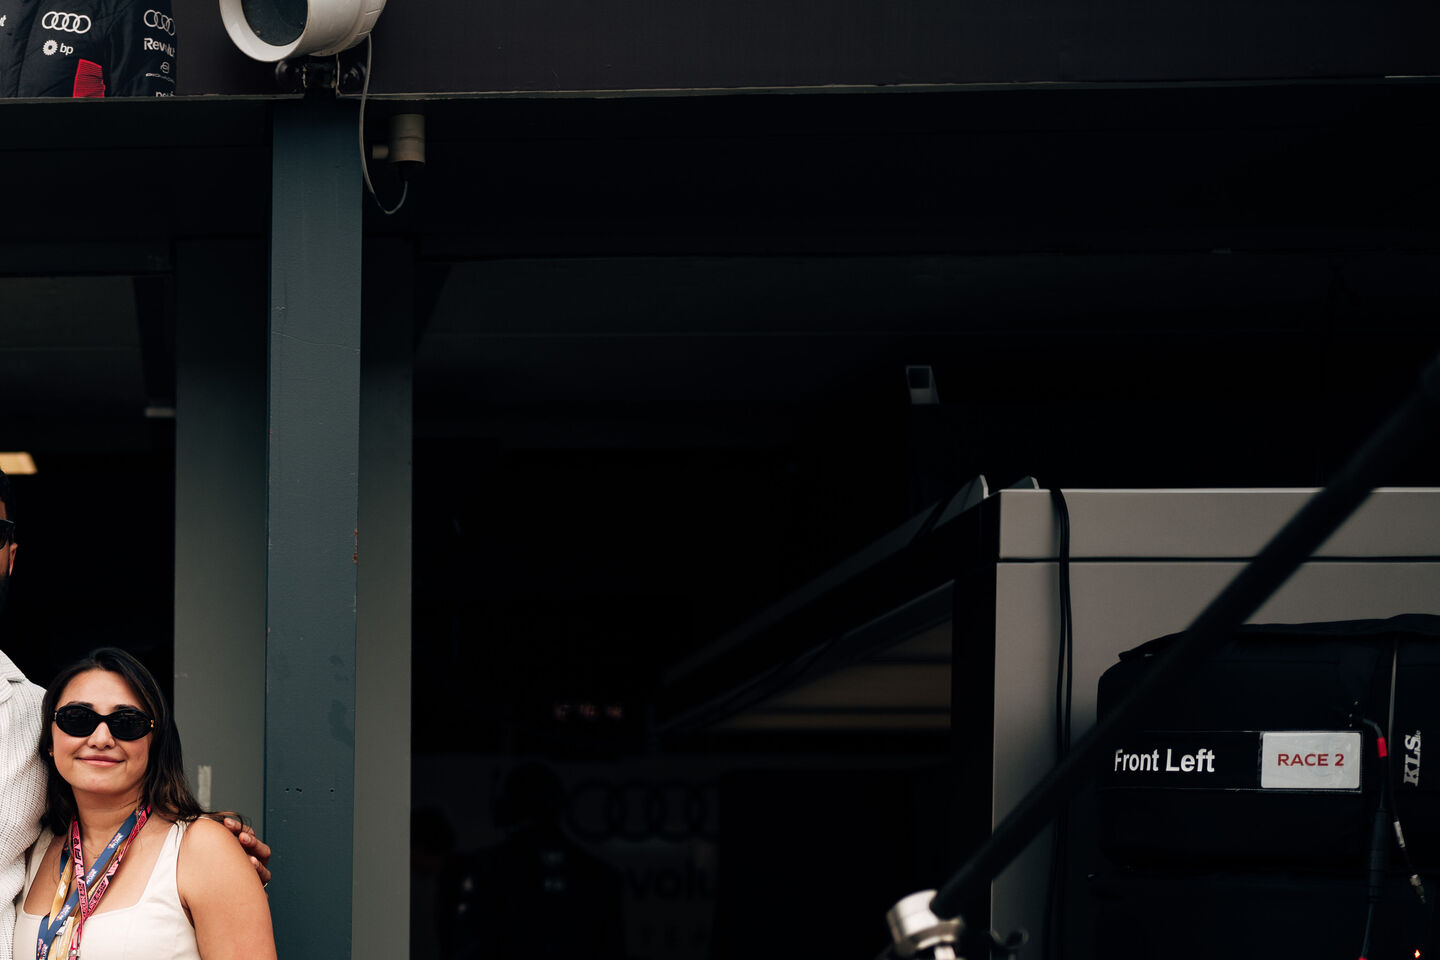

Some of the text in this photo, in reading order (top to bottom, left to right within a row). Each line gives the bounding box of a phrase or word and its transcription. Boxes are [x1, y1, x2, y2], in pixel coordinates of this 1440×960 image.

[59, 42, 74, 56] bp
[143, 37, 176, 57] Revlu
[1114, 748, 1216, 773] Front Left
[1277, 752, 1345, 767] RACE 2
[1404, 733, 1421, 786] KLS
